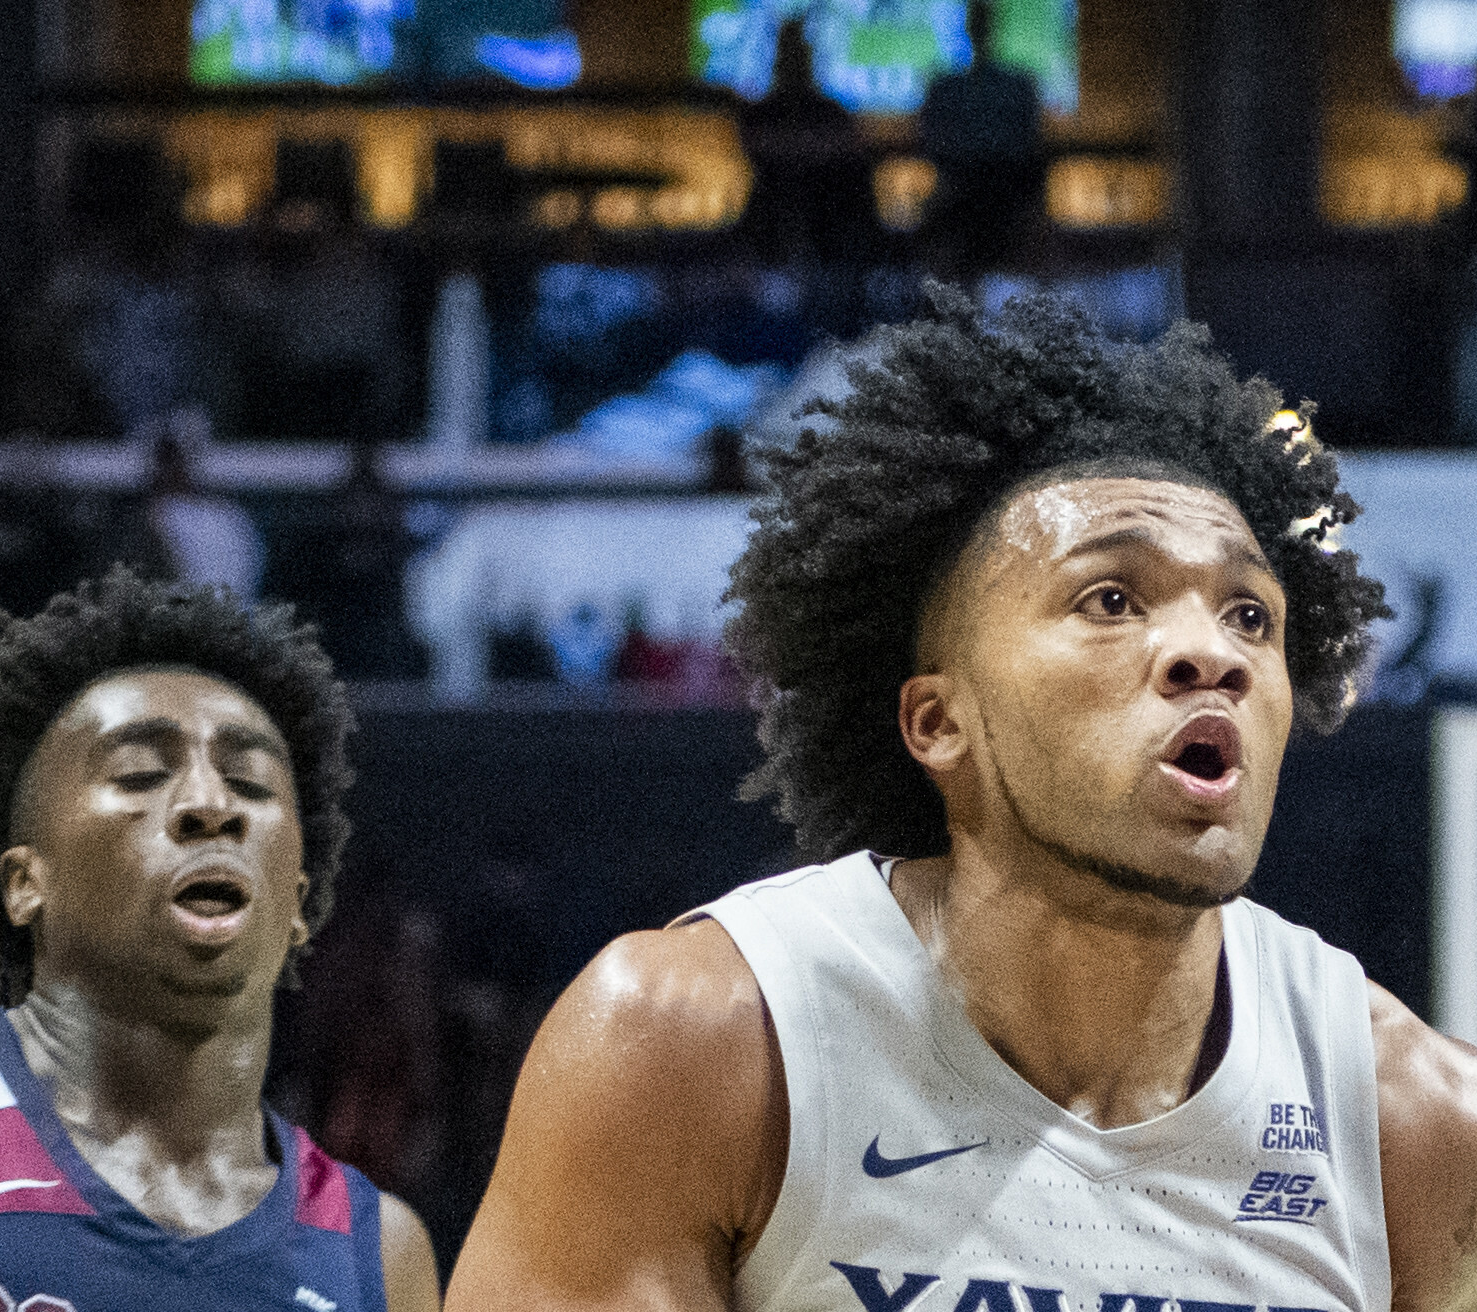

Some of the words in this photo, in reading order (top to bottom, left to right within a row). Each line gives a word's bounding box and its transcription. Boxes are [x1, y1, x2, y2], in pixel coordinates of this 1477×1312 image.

[1270, 1103, 1296, 1126] BE
[1248, 1171, 1317, 1195] BIG
[1238, 1193, 1328, 1218] EAST
